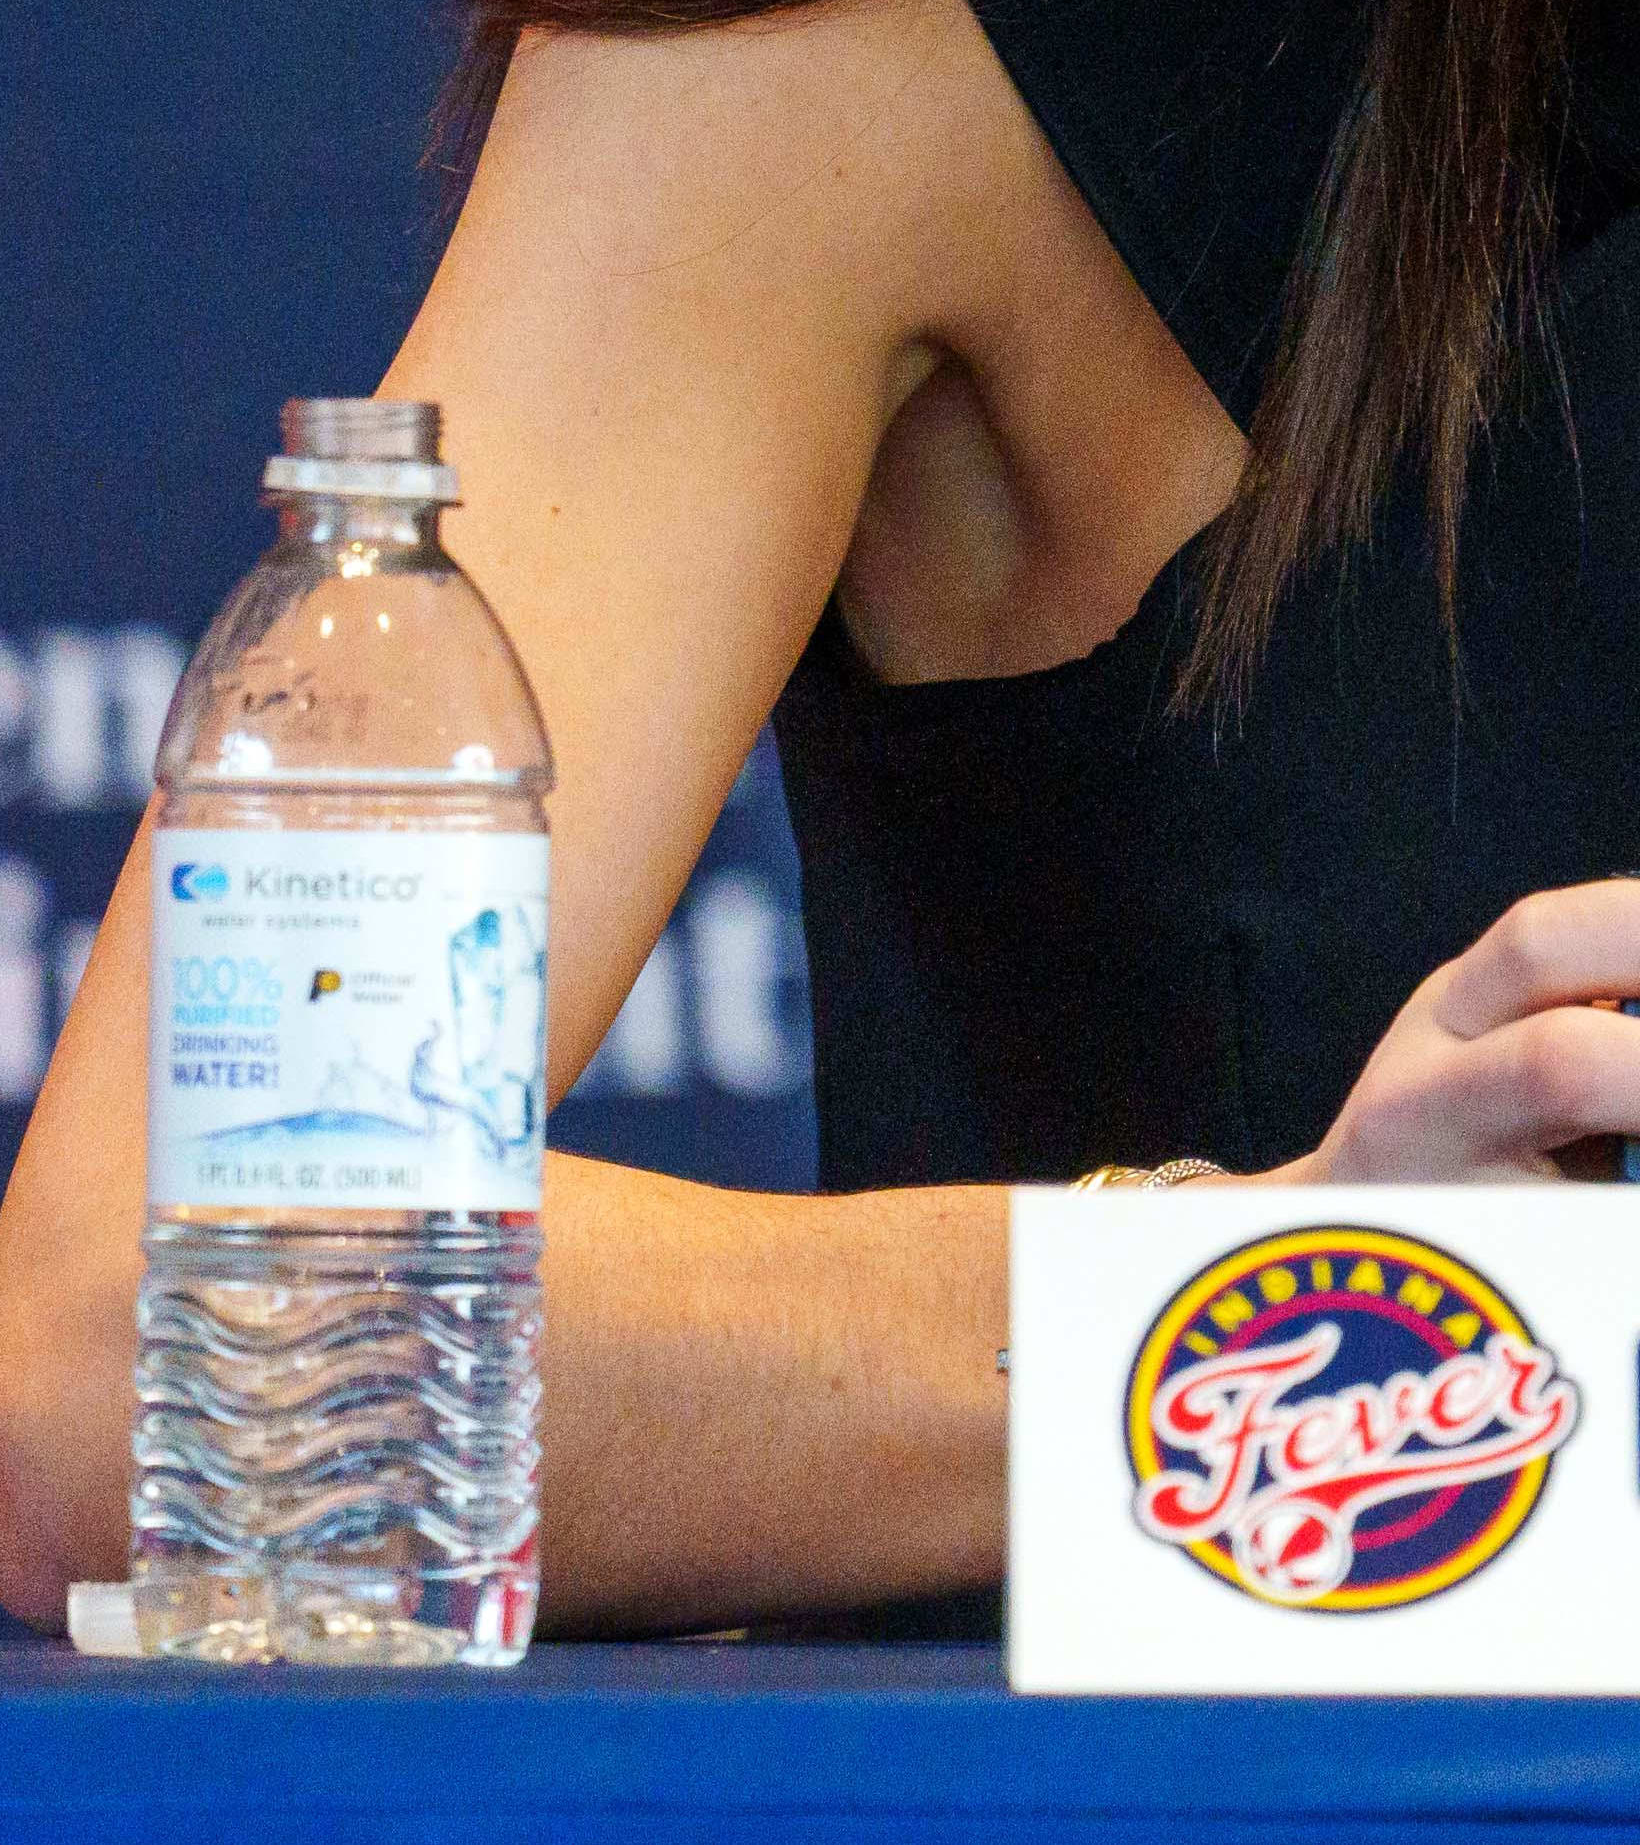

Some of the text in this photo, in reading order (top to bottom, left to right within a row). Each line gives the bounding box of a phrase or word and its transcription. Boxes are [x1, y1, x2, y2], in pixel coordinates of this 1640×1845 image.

[245, 865, 420, 901] Kinetico
[173, 955, 283, 1001] 100%
[172, 1032, 280, 1055] DRINKING
[171, 1061, 280, 1089] WATER!
[1182, 1257, 1482, 1358] INDIANA
[1132, 1321, 1582, 1543] Fever
